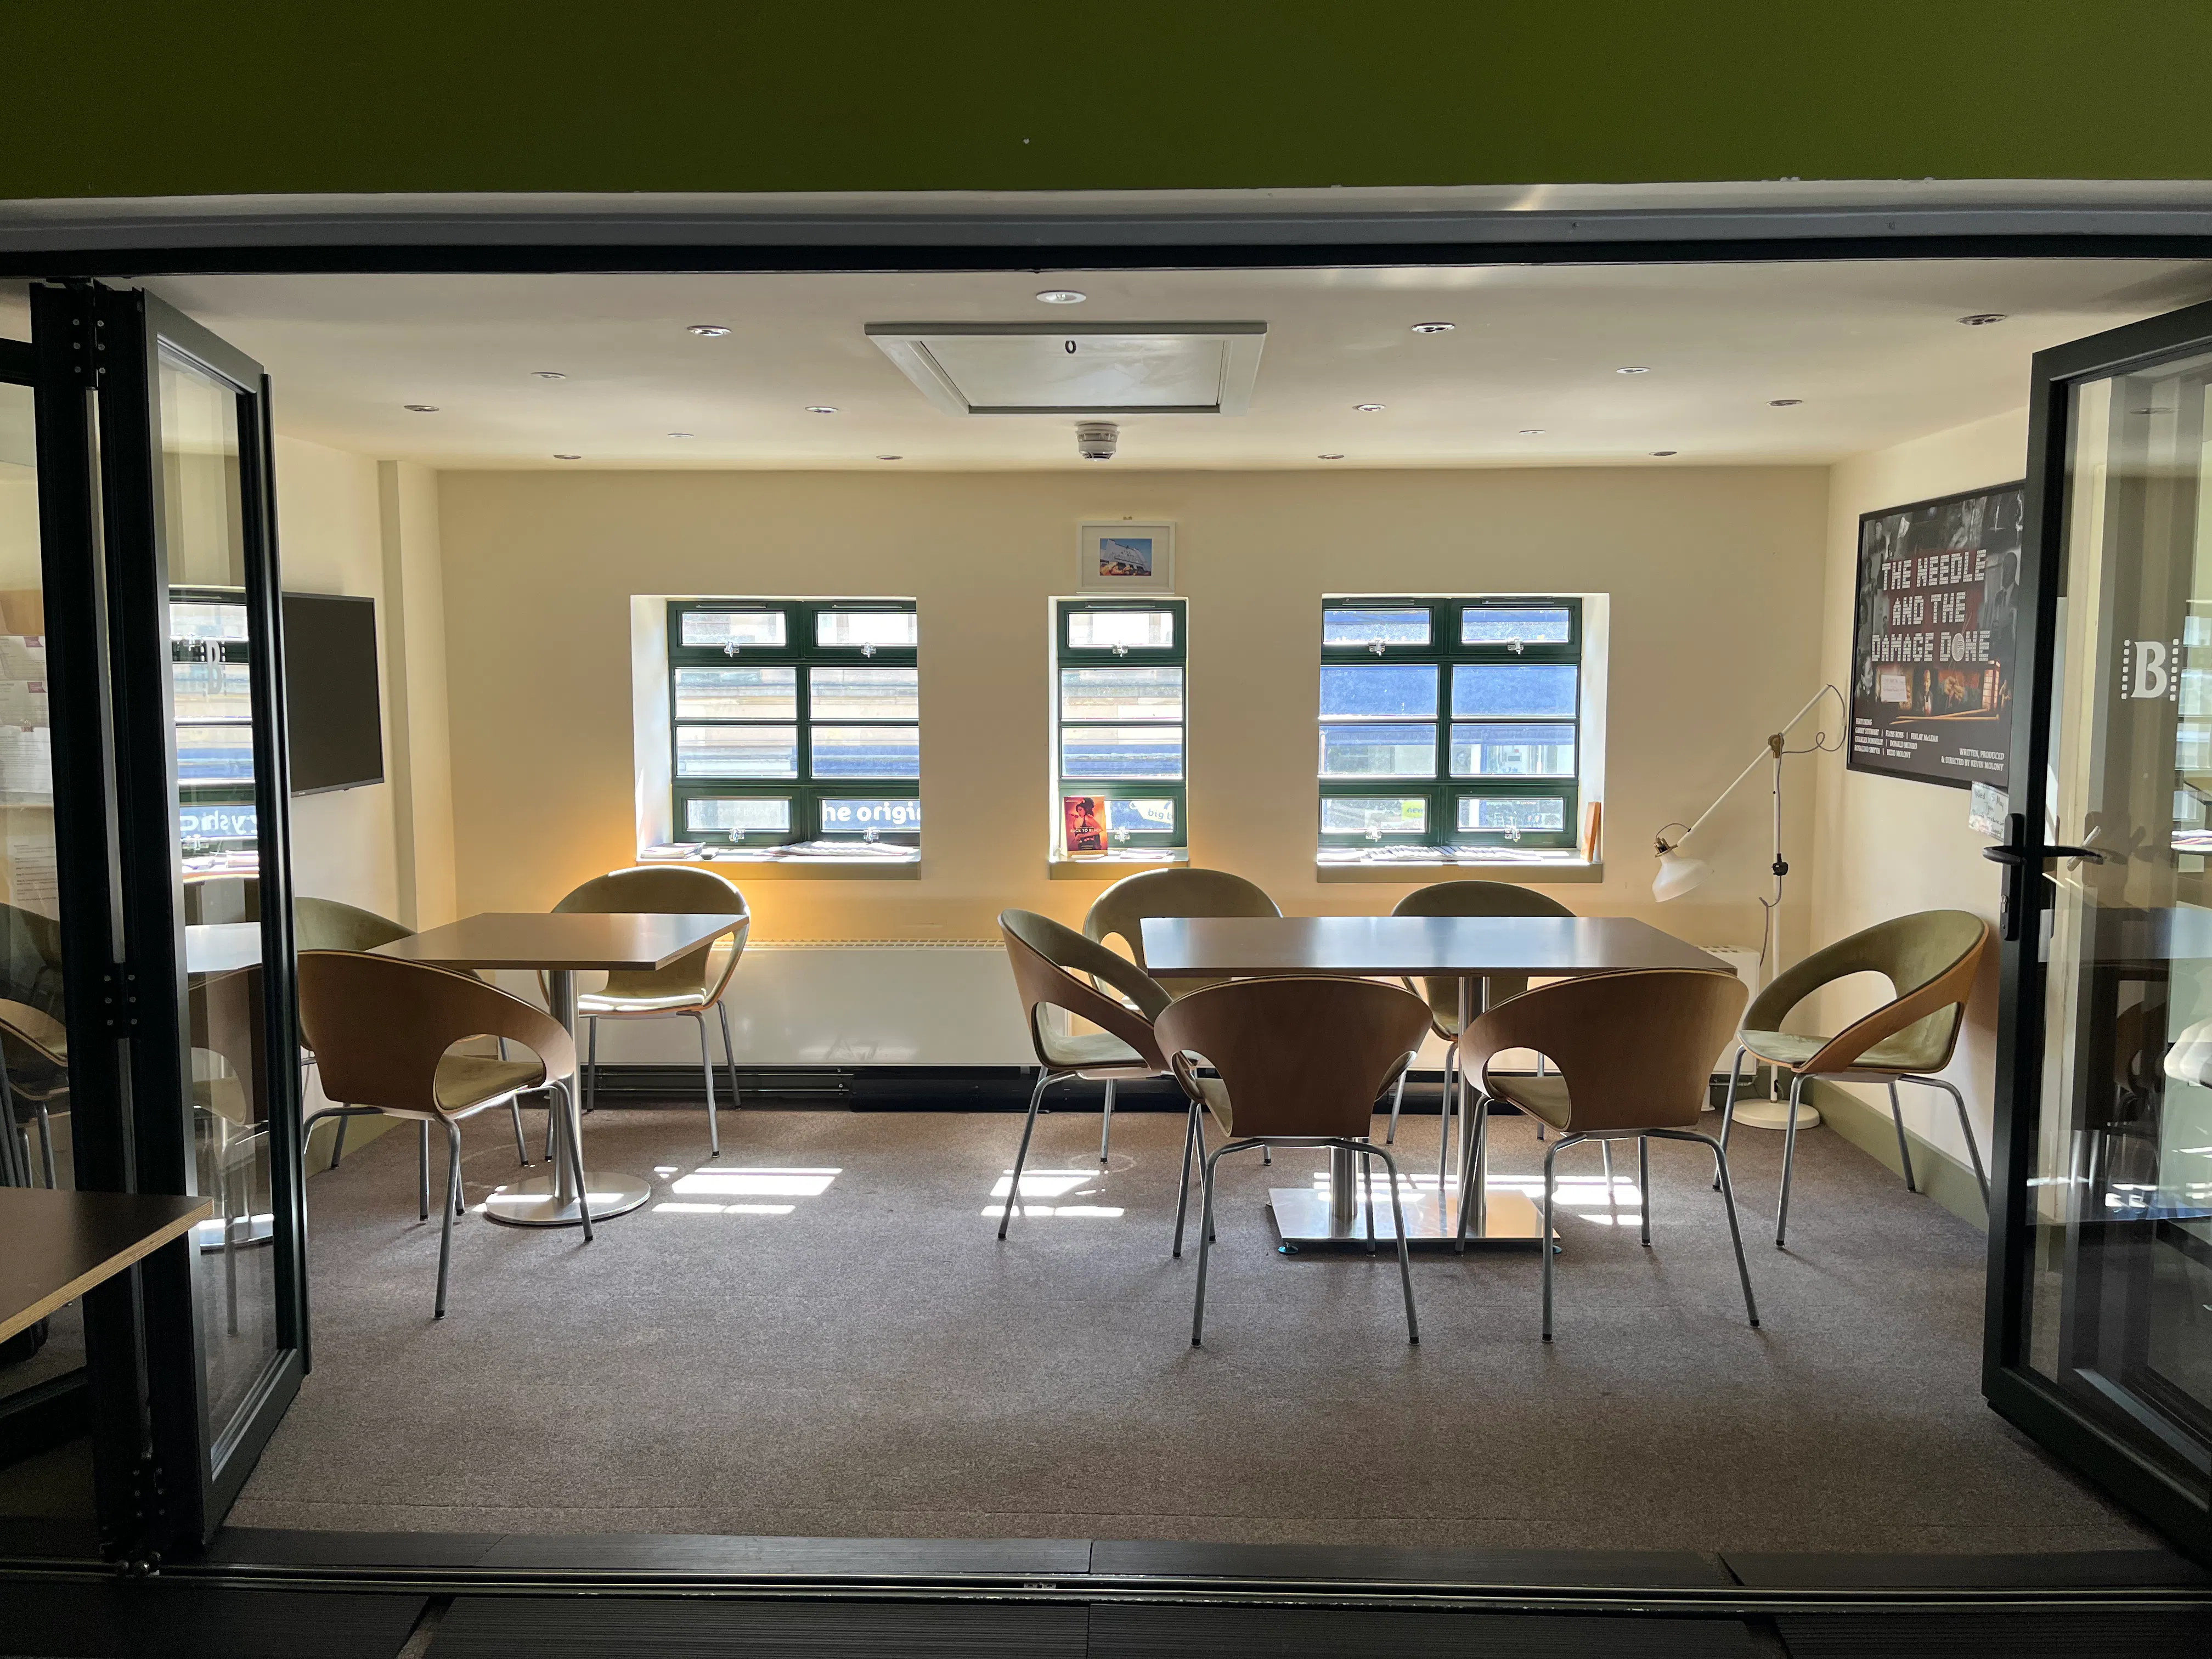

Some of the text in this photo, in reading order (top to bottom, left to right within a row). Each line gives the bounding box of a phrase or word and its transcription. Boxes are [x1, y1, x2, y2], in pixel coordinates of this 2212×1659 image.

[1882, 549, 1987, 591] THE NEEDLE
[1892, 591, 1966, 626] AND THE
[1871, 630, 1991, 662] DAMAGE DONE
[2130, 641, 2168, 698] B
[1945, 757, 1965, 766] DIRECTED
[1964, 759, 1970, 767] BY
[1970, 760, 1984, 769] KEVIN
[1984, 761, 2004, 771] MOLONY
[1959, 748, 2005, 760] WRITTEN, PRODUCED
